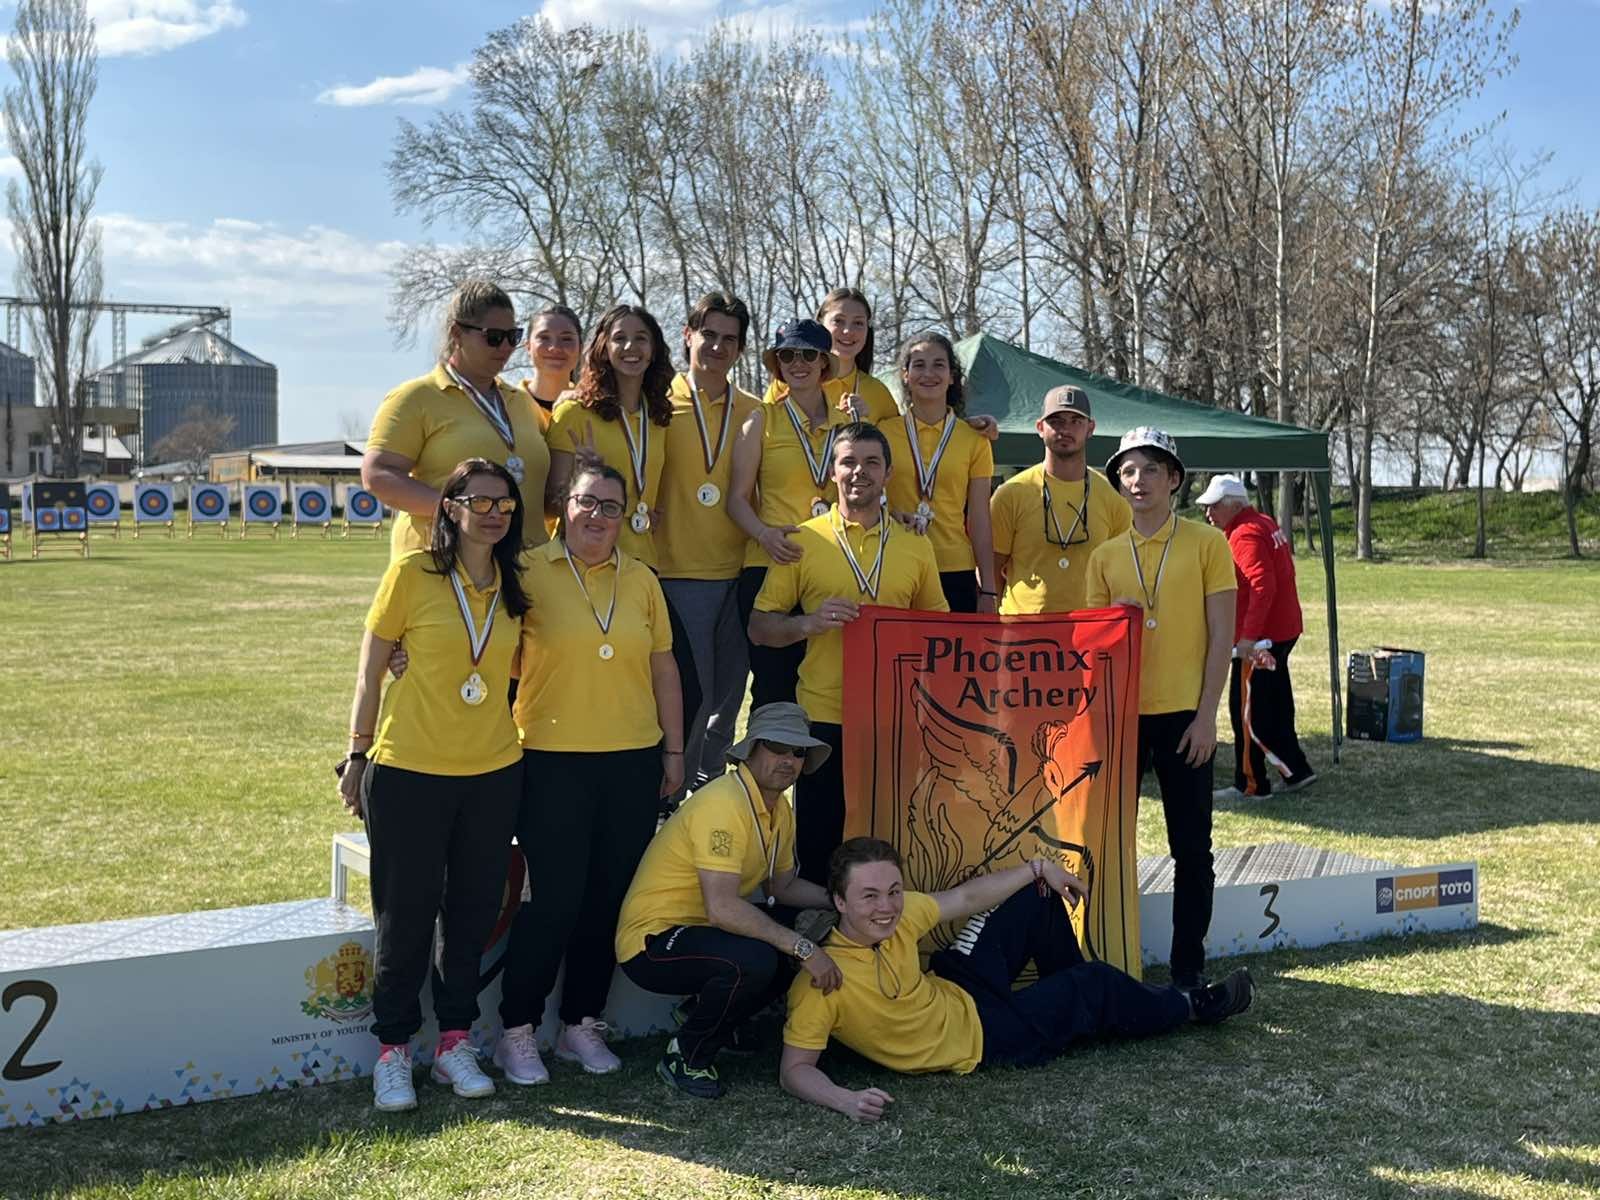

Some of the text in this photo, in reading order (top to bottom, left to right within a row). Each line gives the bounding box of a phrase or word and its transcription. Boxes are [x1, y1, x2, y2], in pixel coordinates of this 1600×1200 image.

[912, 636, 1093, 673] Phoenix
[956, 676, 1097, 716] Archery
[1395, 881, 1472, 902] СПОРТ ТОТО
[1259, 884, 1280, 939] 3
[1, 979, 63, 1081] 2
[271, 1024, 369, 1045] MINISTRY OF YOUTH
